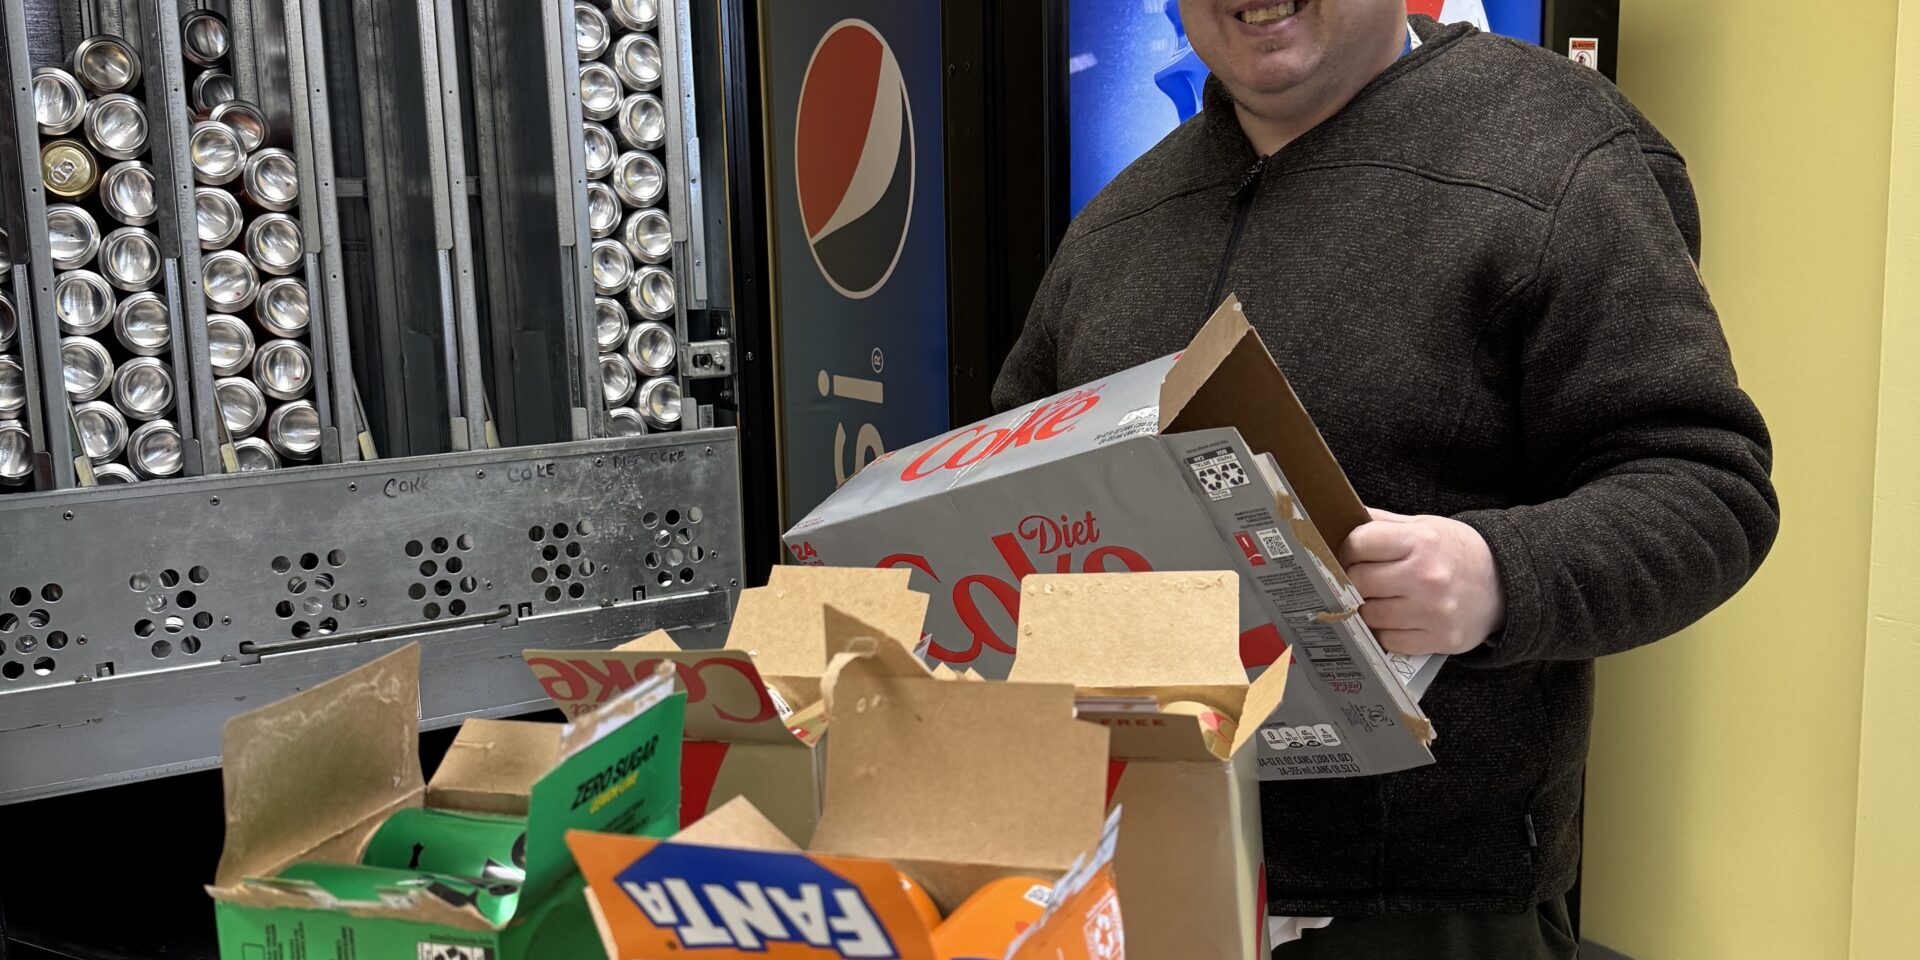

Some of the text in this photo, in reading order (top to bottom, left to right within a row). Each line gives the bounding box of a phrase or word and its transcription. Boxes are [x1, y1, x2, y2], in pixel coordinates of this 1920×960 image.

[900, 395, 1101, 481] Coke
[650, 450, 687, 464] COKE
[507, 462, 557, 483] COKE
[1018, 510, 1101, 554] Diet
[790, 541, 818, 561] 24
[1295, 755, 1313, 764] CANS
[1313, 765, 1332, 775] CANS
[571, 734, 660, 811] ZERO SUGAR
[622, 879, 895, 959] FANTA
